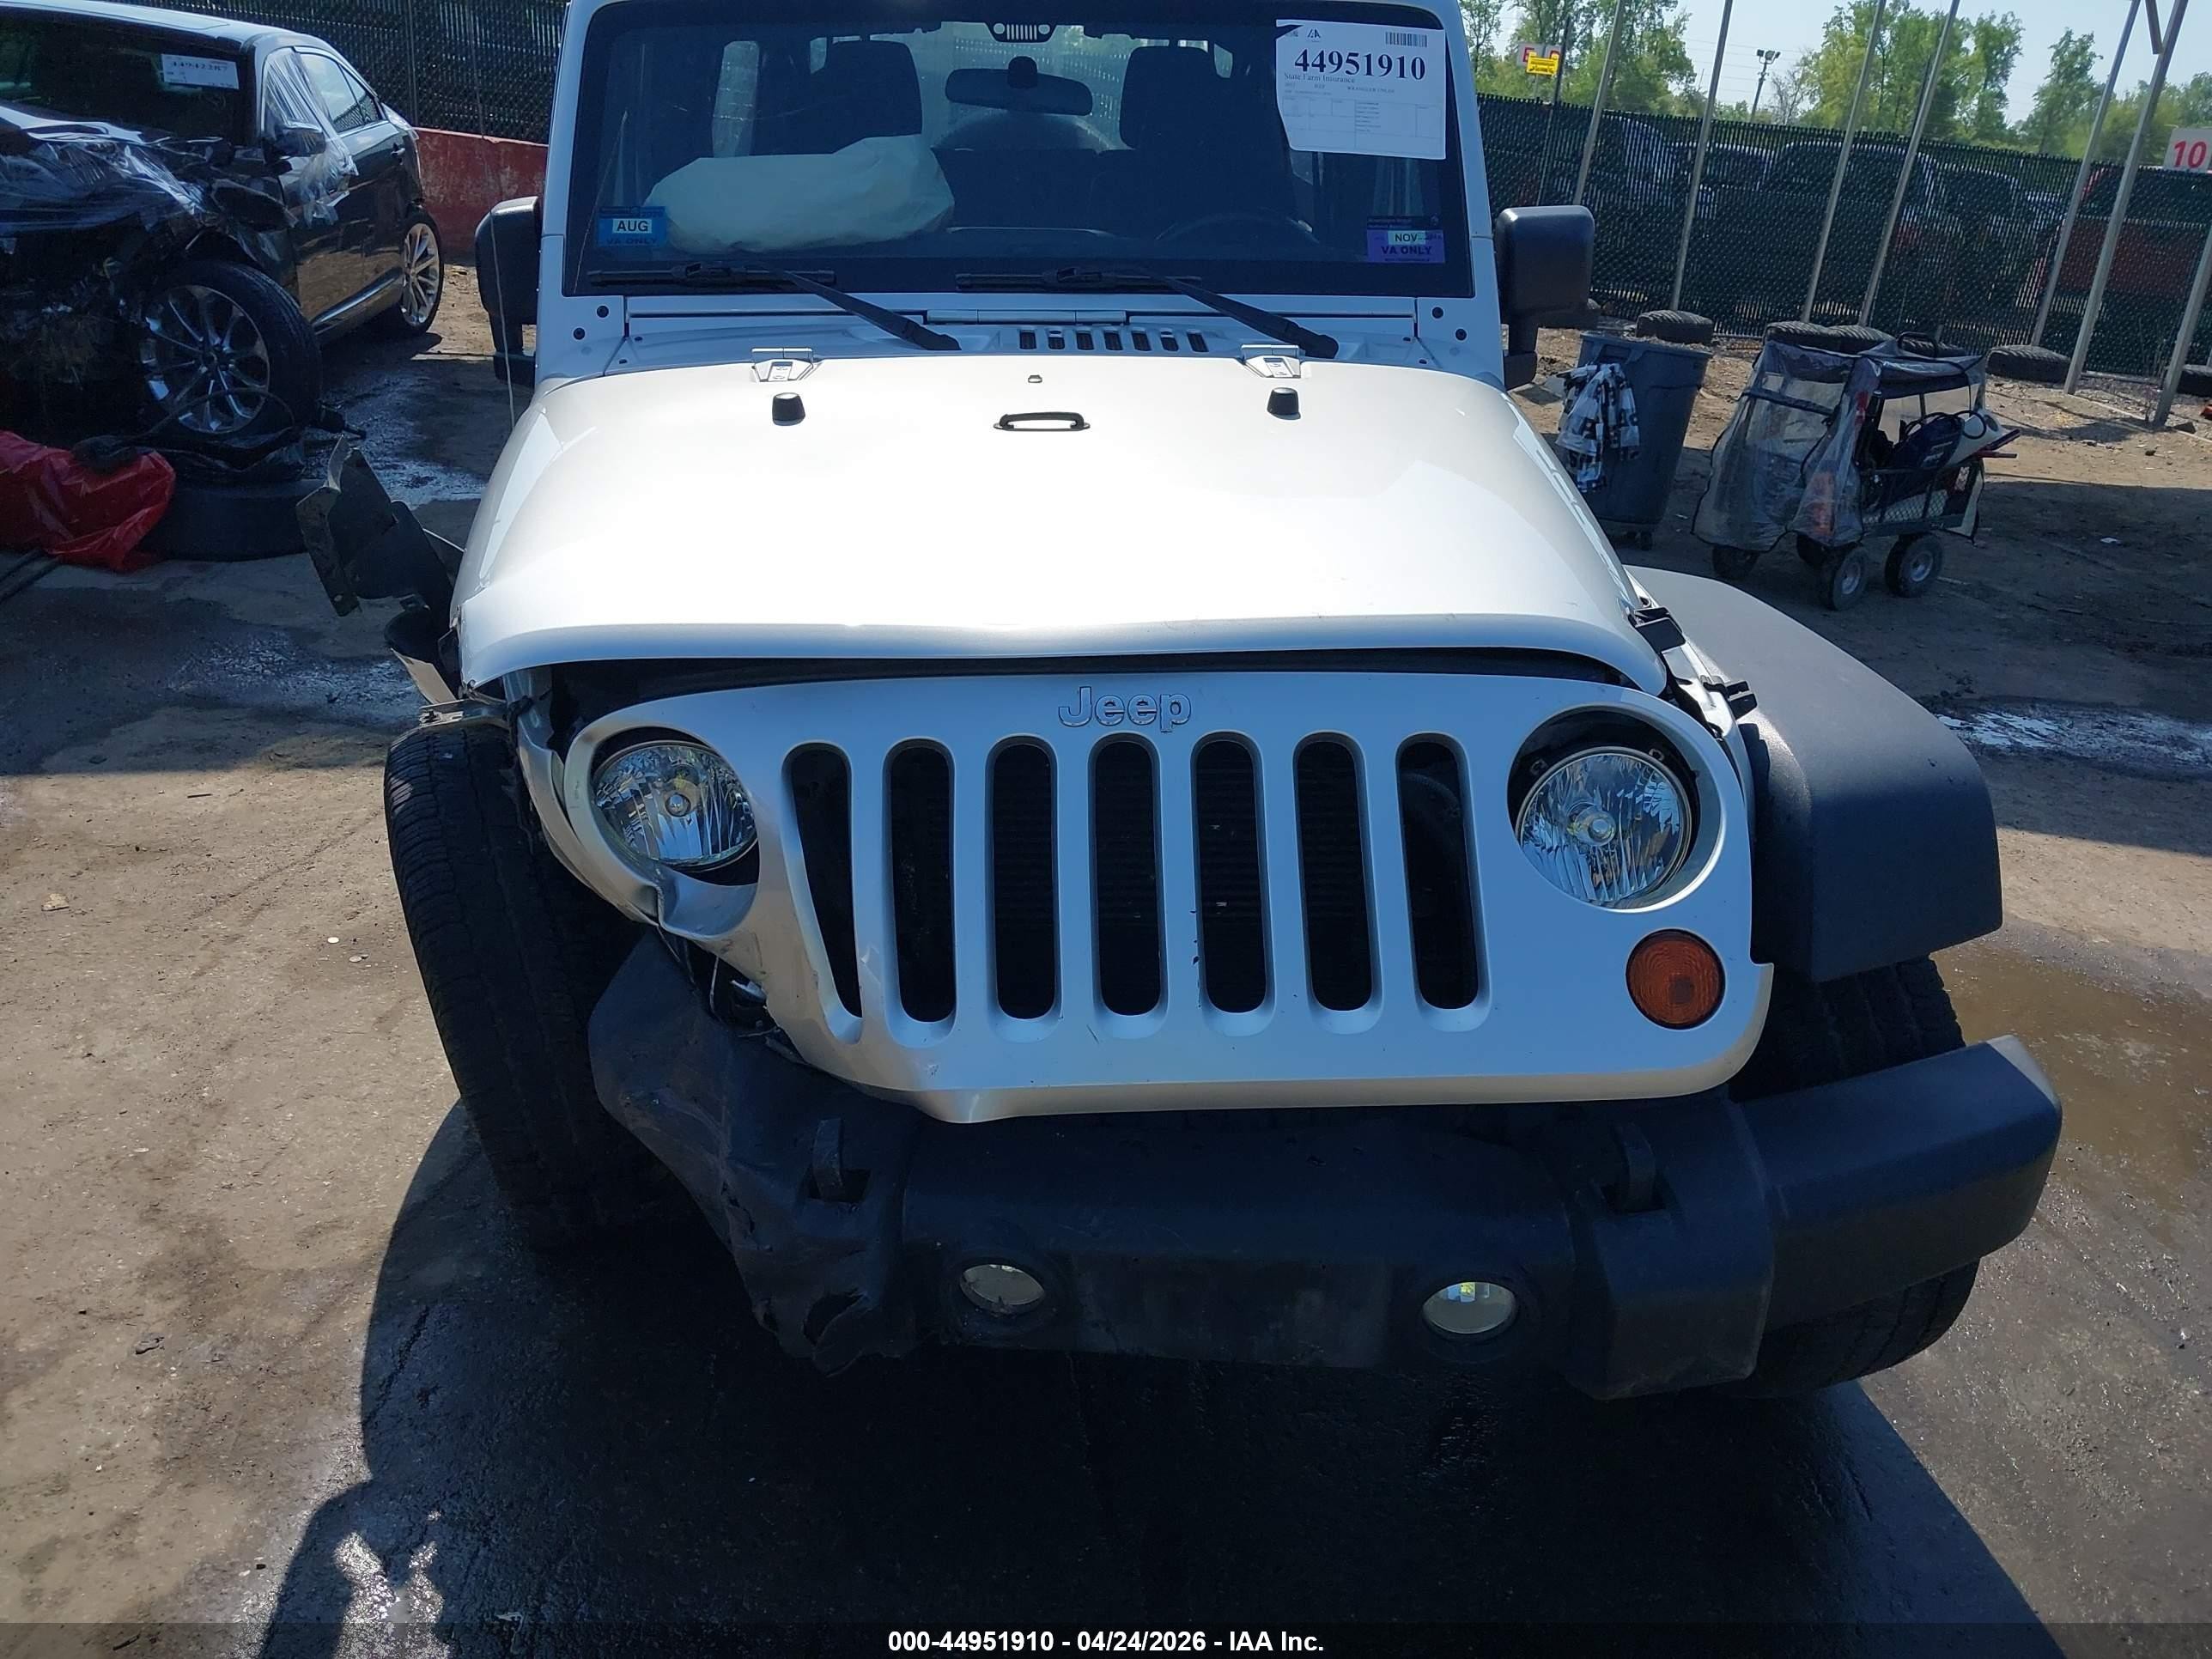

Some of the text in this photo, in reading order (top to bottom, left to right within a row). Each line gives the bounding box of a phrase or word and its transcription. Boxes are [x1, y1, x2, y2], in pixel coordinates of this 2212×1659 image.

[1294, 48, 1425, 80] 44951910
[1284, 72, 1355, 84] State Farm Insurance
[2174, 140, 2207, 169] 10
[617, 220, 649, 232] AUG
[1395, 233, 1418, 242] NOV
[1381, 246, 1432, 255] VA ONLY
[1058, 685, 1192, 733] Jeep
